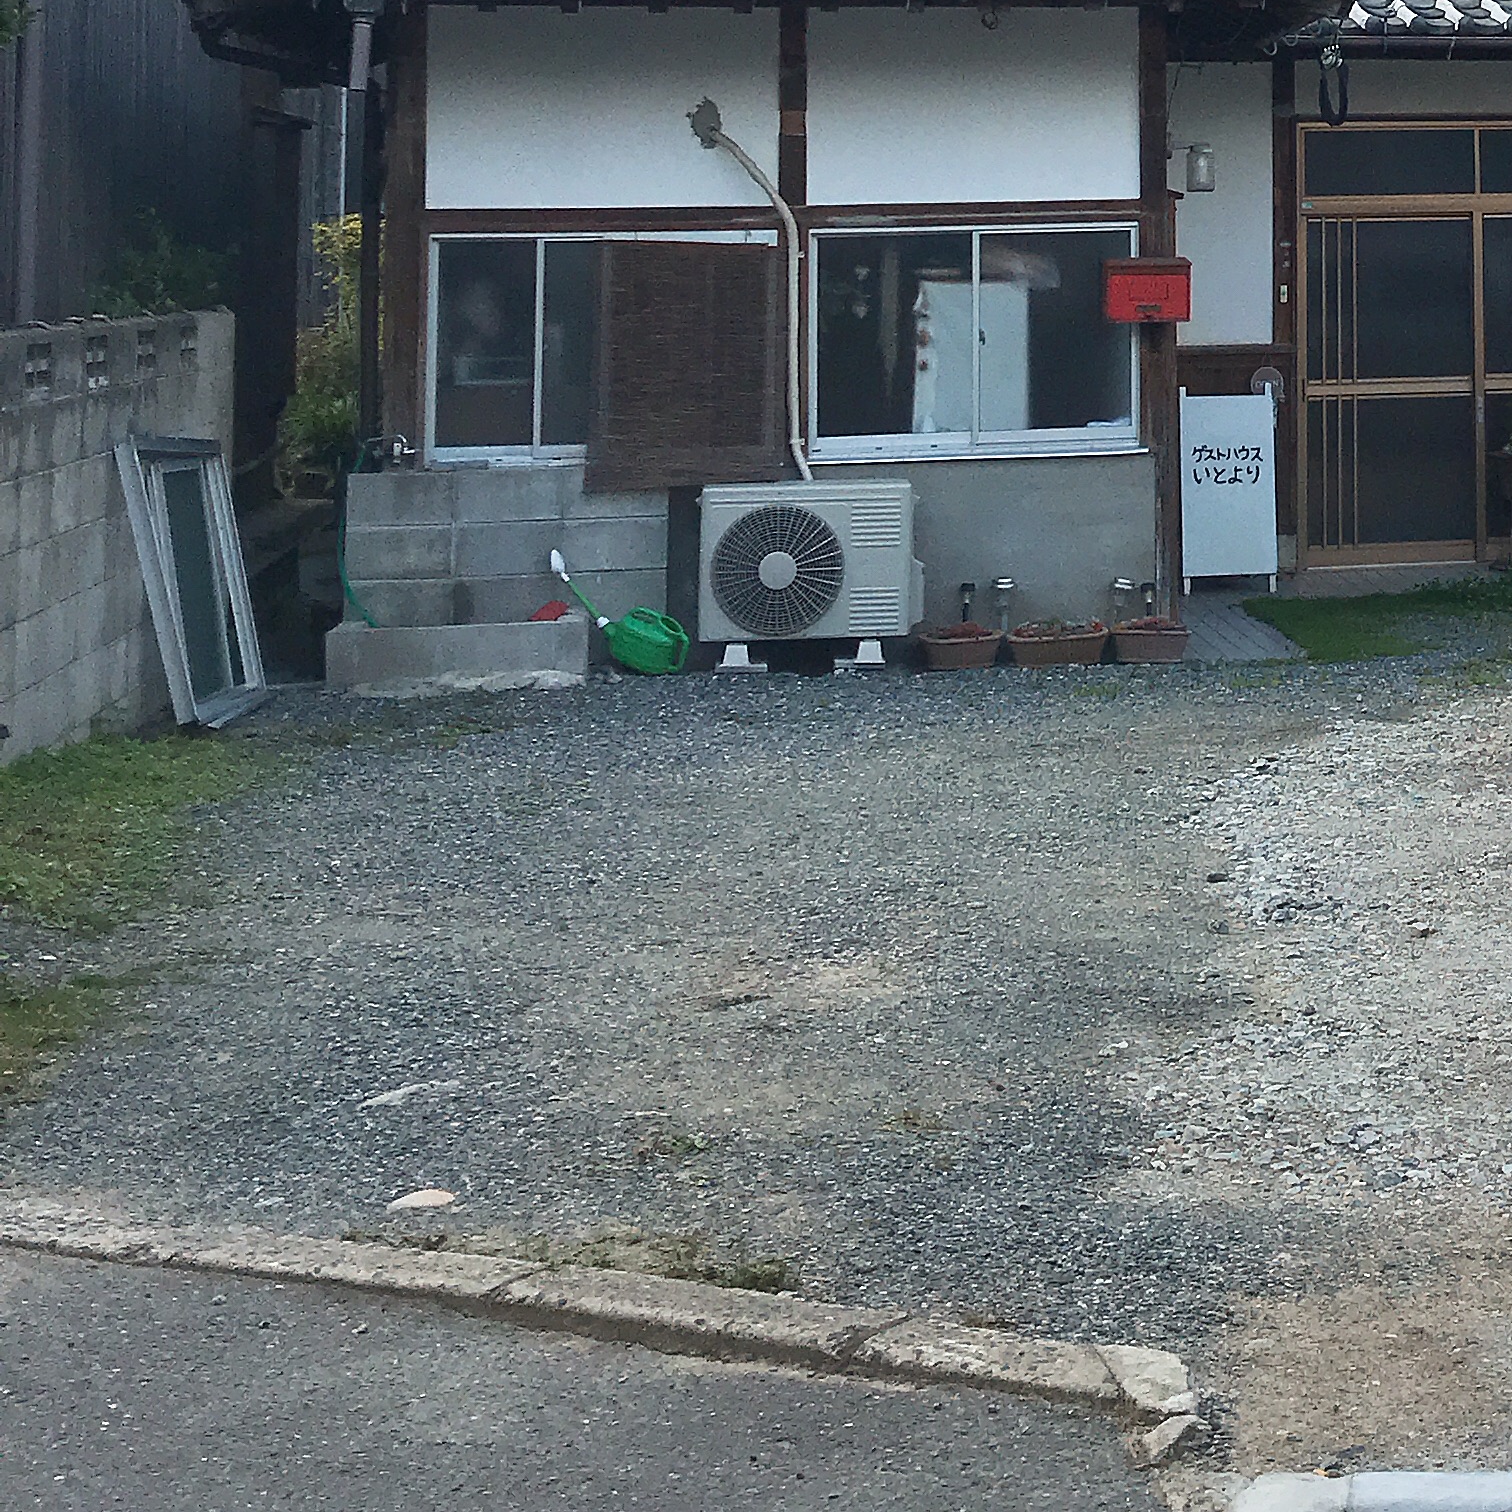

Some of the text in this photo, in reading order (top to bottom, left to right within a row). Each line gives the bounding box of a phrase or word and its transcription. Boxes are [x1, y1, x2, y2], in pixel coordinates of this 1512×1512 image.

[1191, 444, 1264, 463] ゲストハウス
[1192, 465, 1260, 485] いとより
